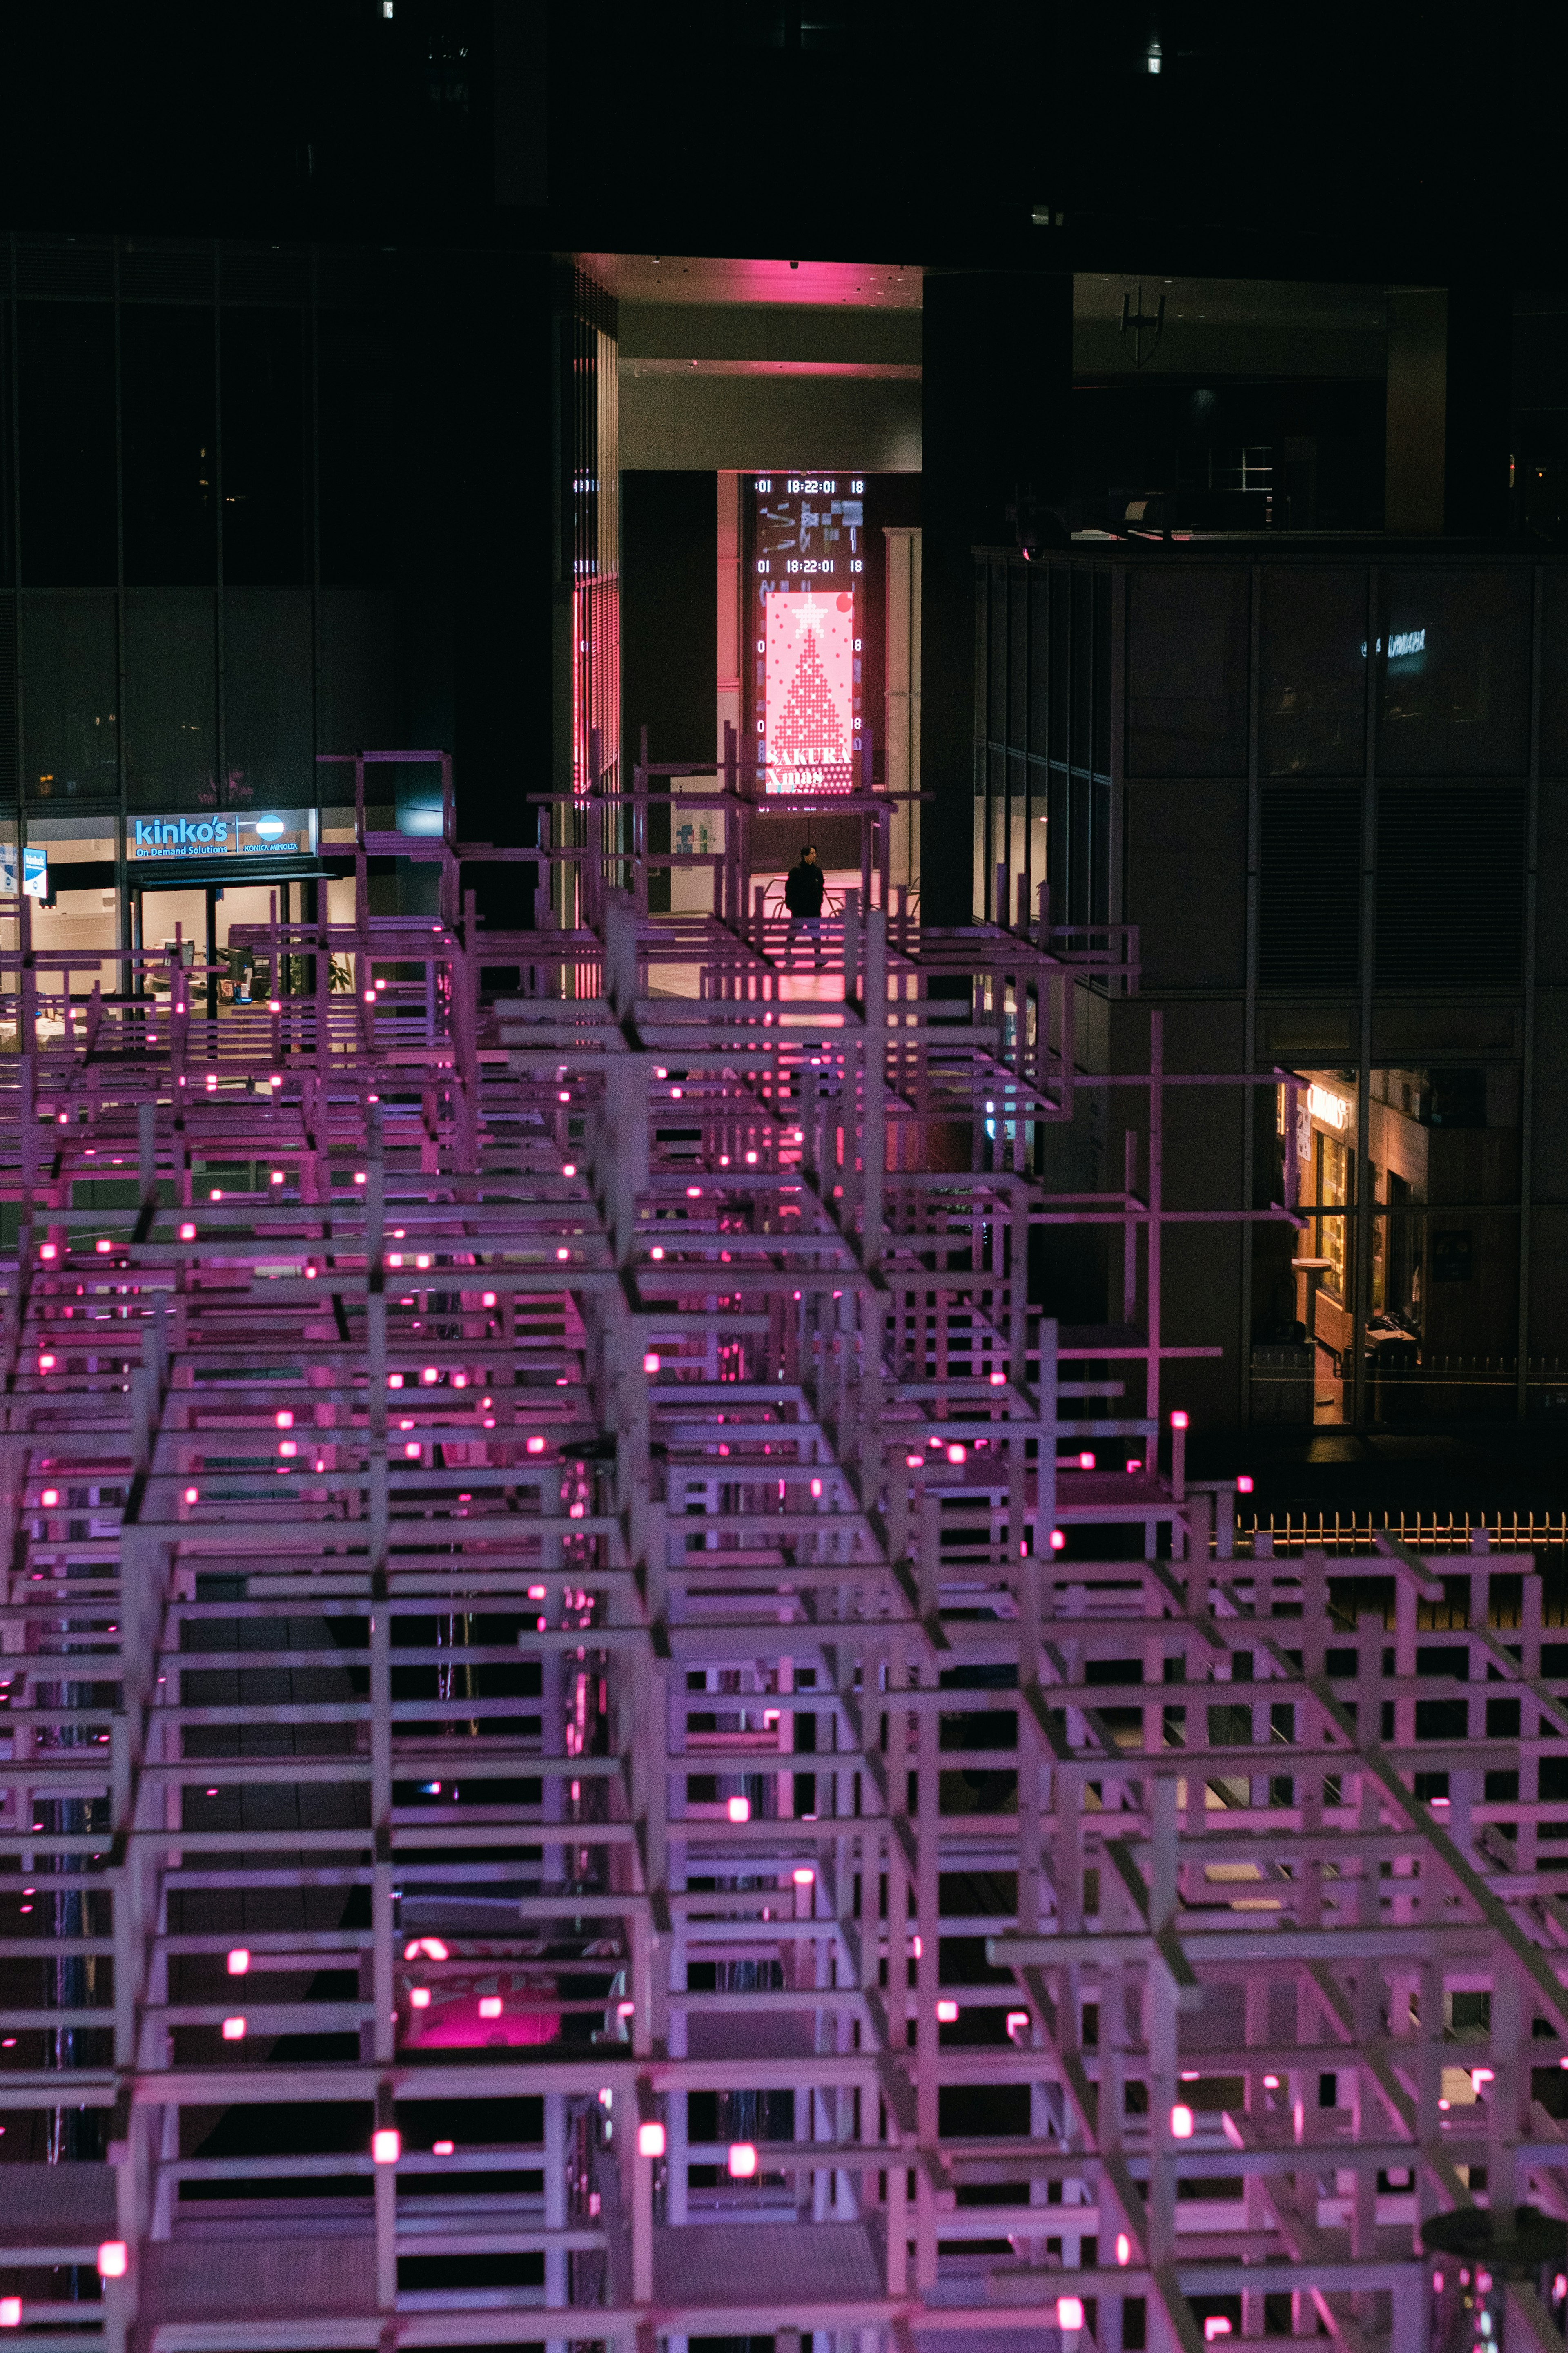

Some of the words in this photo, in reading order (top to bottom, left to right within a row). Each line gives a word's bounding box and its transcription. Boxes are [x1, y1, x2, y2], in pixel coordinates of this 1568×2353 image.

[788, 480, 835, 493] 18:22:01
[851, 480, 863, 493] 18
[758, 560, 770, 573] 01
[787, 560, 834, 573] 18:22:01
[851, 560, 862, 572] 18
[766, 747, 851, 765] SAKURA
[766, 769, 823, 785] Xmas
[136, 816, 227, 845] kinko's
[136, 848, 149, 856] On
[151, 846, 186, 856] Demand
[189, 845, 227, 854] Solutions
